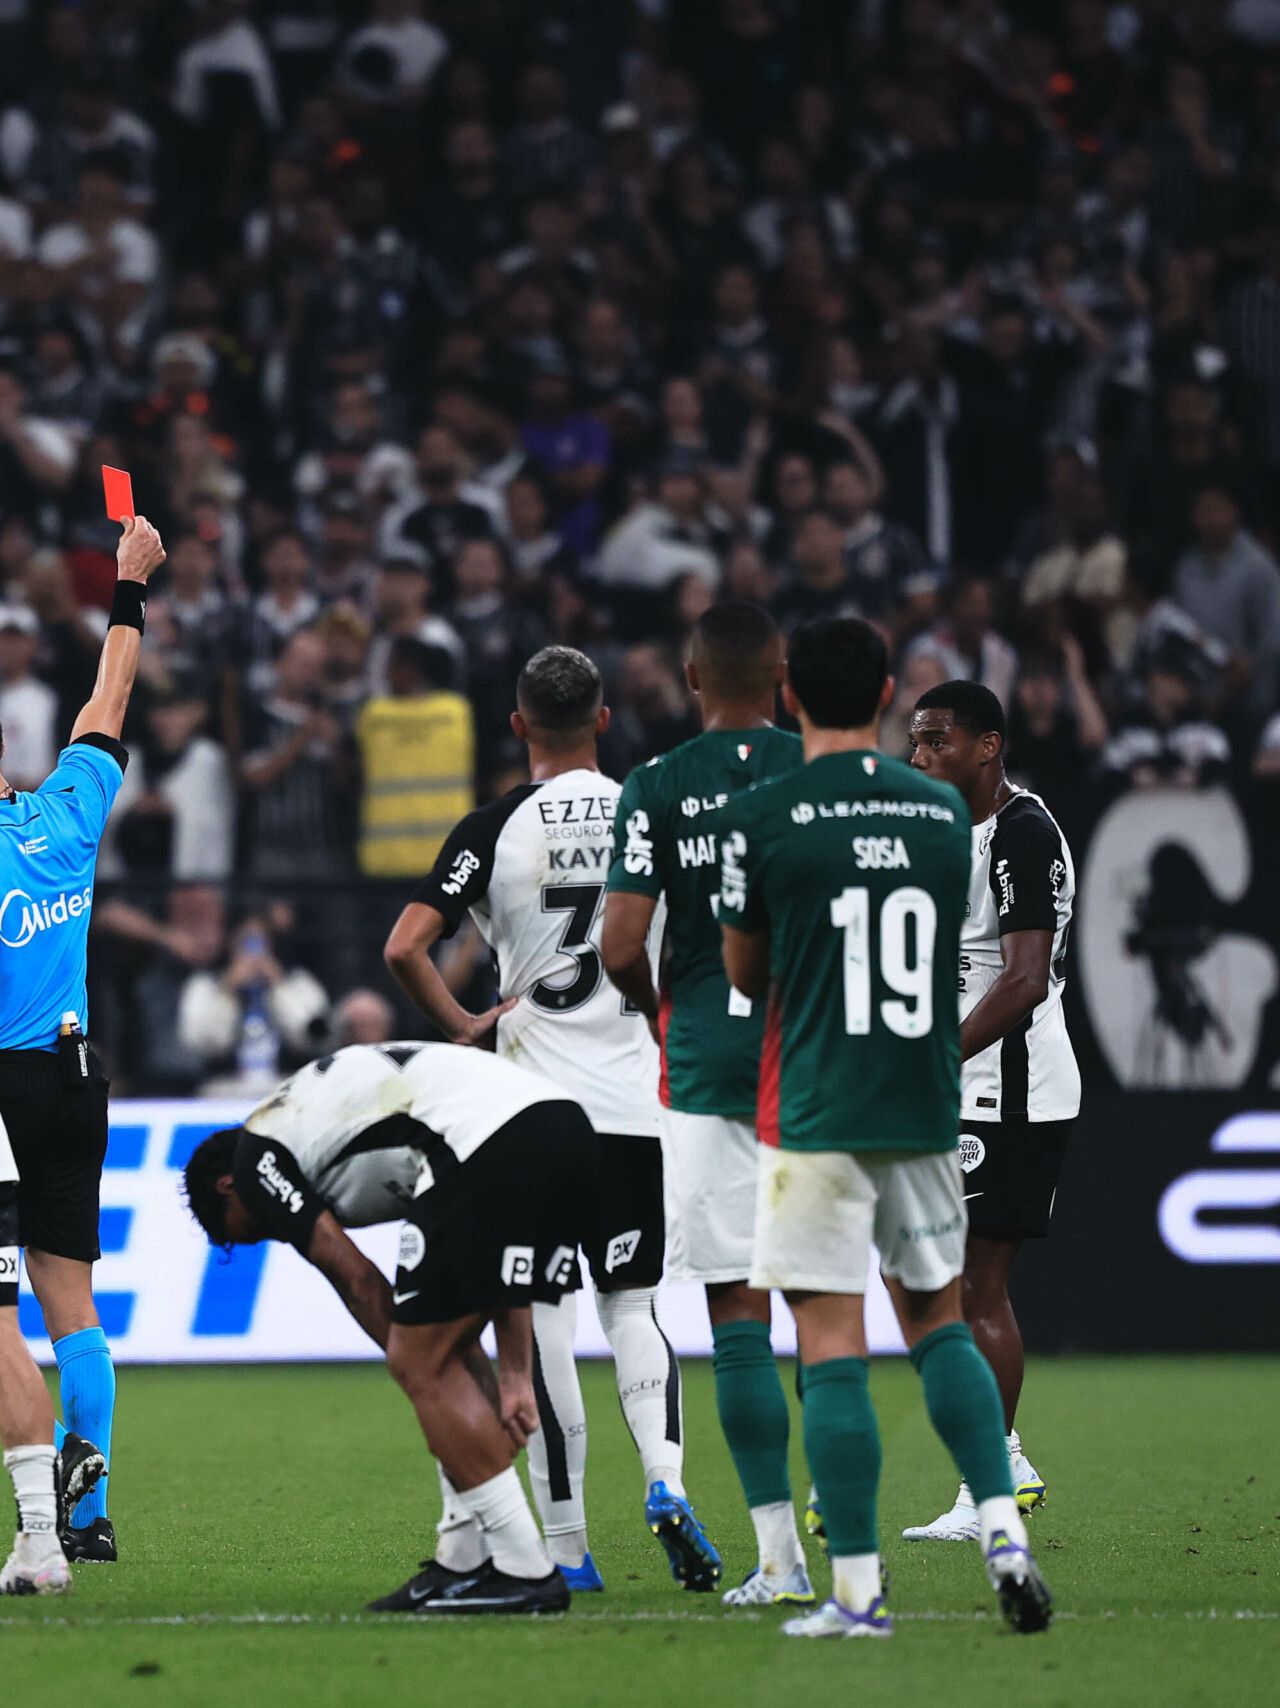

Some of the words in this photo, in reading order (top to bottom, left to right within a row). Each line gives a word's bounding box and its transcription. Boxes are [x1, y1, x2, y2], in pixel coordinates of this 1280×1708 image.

[538, 797, 616, 824] EZZE
[818, 800, 955, 824] LEAPMOTOR
[544, 825, 603, 840] SEGURO
[852, 836, 911, 869] SOSA
[999, 872, 1011, 917] bmg
[831, 886, 937, 1038] 19
